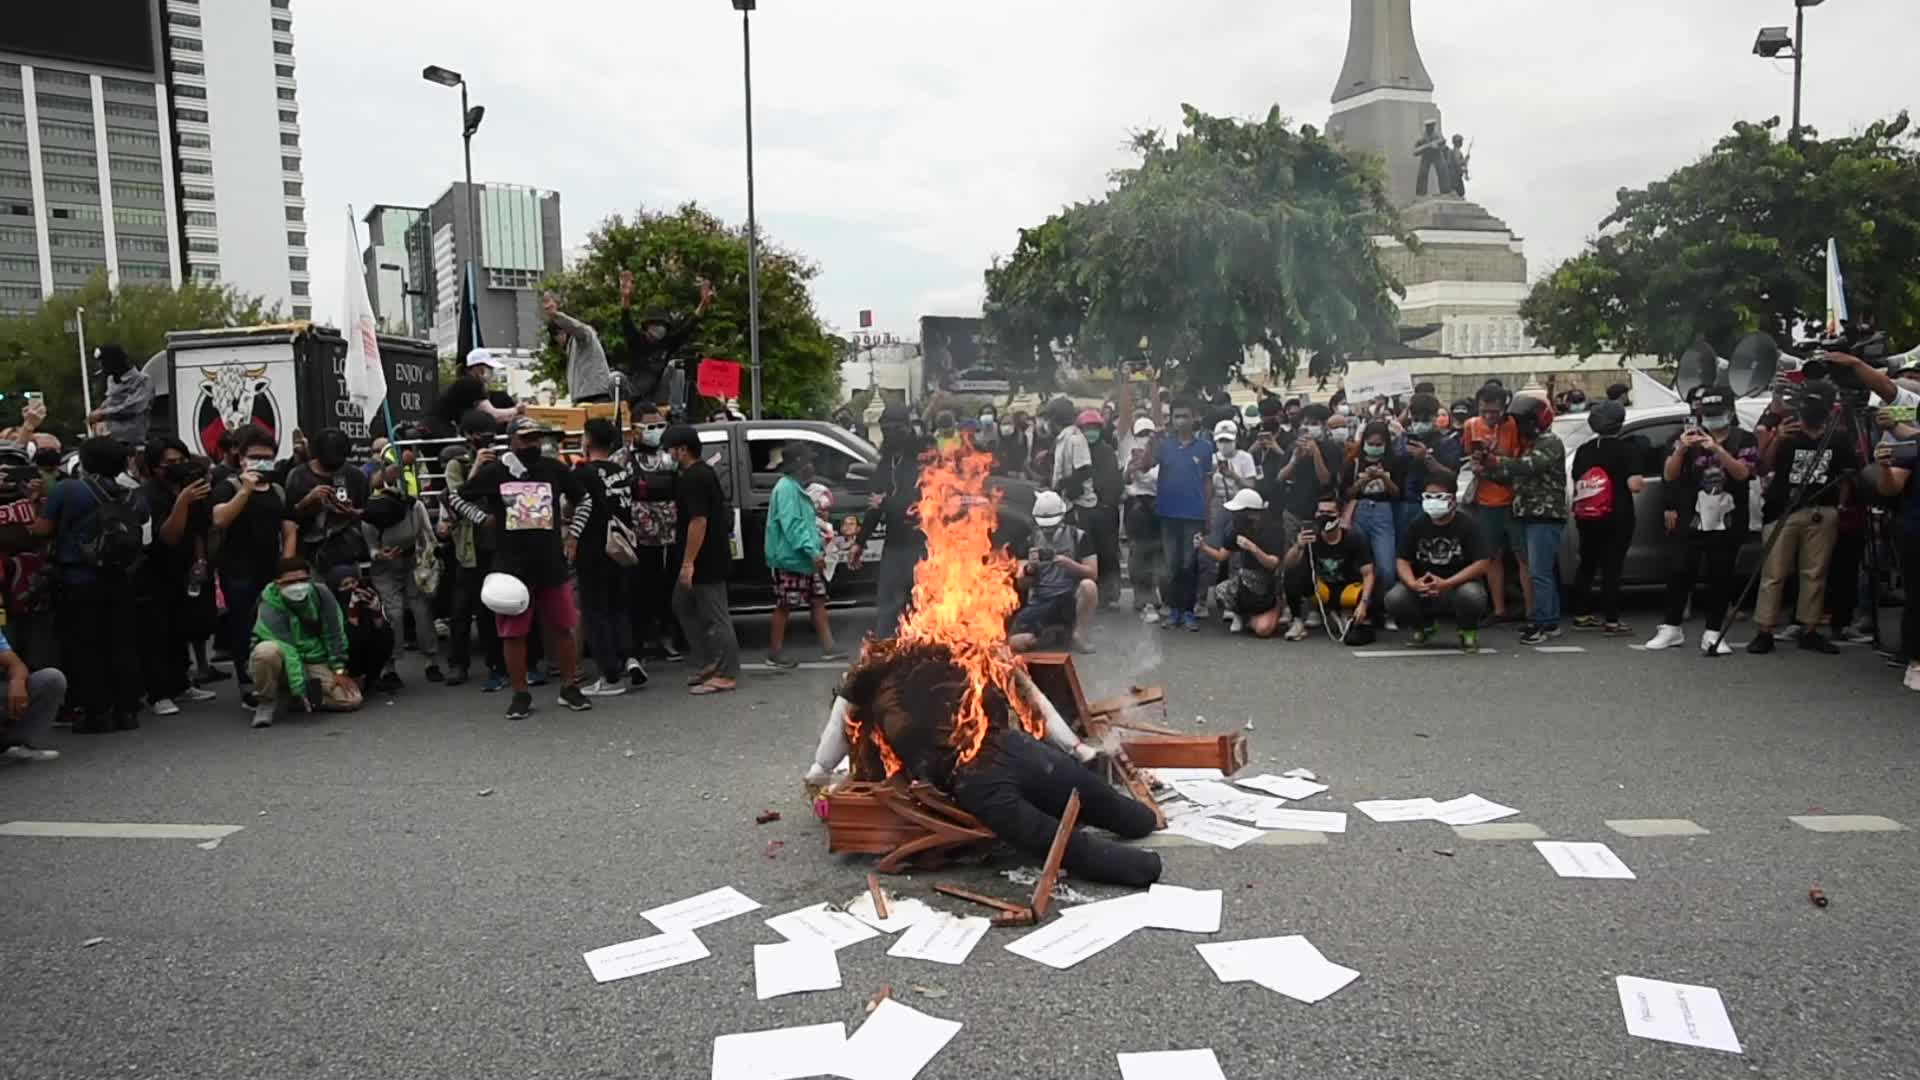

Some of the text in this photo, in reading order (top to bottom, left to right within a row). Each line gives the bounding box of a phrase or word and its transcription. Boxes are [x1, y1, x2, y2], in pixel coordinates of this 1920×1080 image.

[395, 363, 424, 384] ENJOY
[400, 392, 421, 410] OUR
[340, 421, 371, 438] BEER
